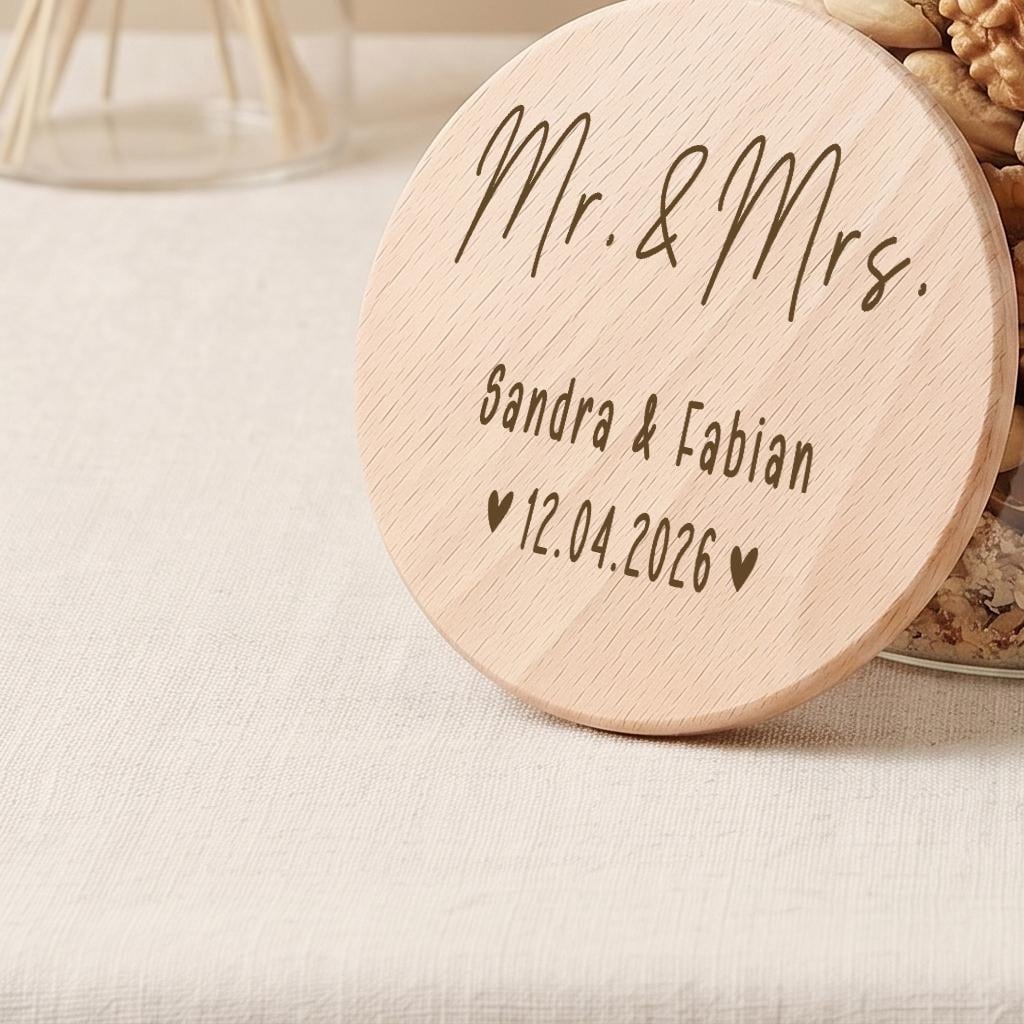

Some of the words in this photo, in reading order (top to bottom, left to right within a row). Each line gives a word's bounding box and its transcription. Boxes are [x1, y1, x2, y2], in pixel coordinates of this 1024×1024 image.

[454, 104, 615, 278] Mr.
[635, 144, 709, 268] &
[700, 134, 927, 322] Mrs.
[479, 363, 615, 452] Sandra
[631, 393, 658, 461] &
[675, 400, 814, 494] Fabian
[520, 487, 717, 593] 12.04.2026
